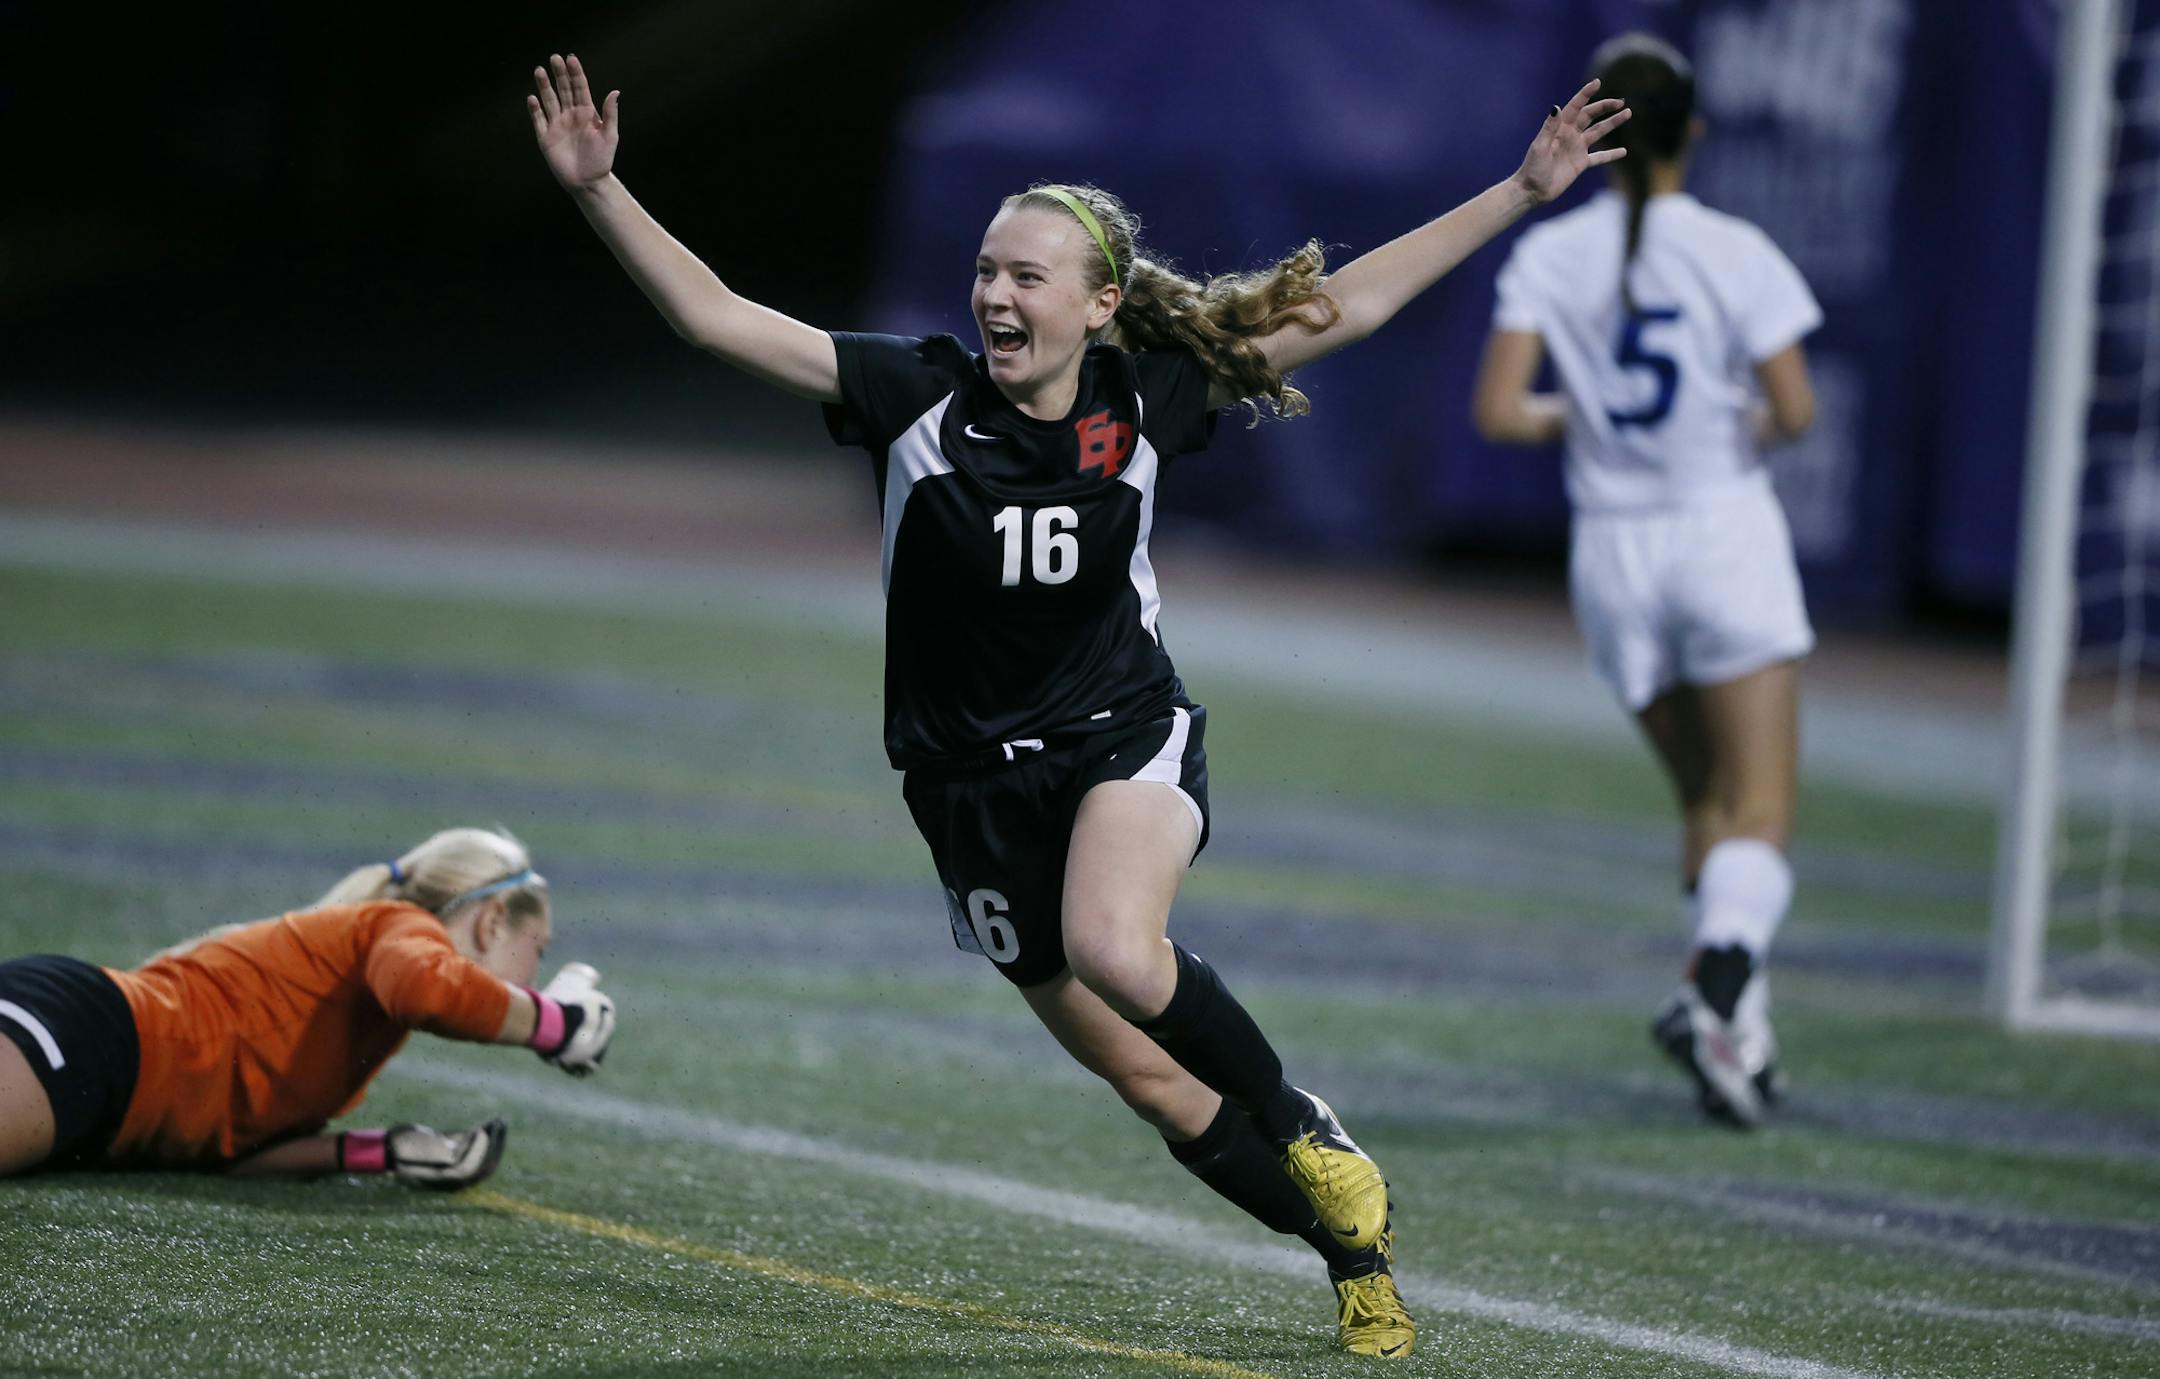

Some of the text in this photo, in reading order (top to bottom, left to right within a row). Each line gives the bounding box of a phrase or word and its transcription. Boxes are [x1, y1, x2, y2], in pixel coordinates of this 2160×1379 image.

[1606, 307, 1679, 431] 5
[993, 506, 1079, 586] 16
[948, 887, 1020, 963] 6
